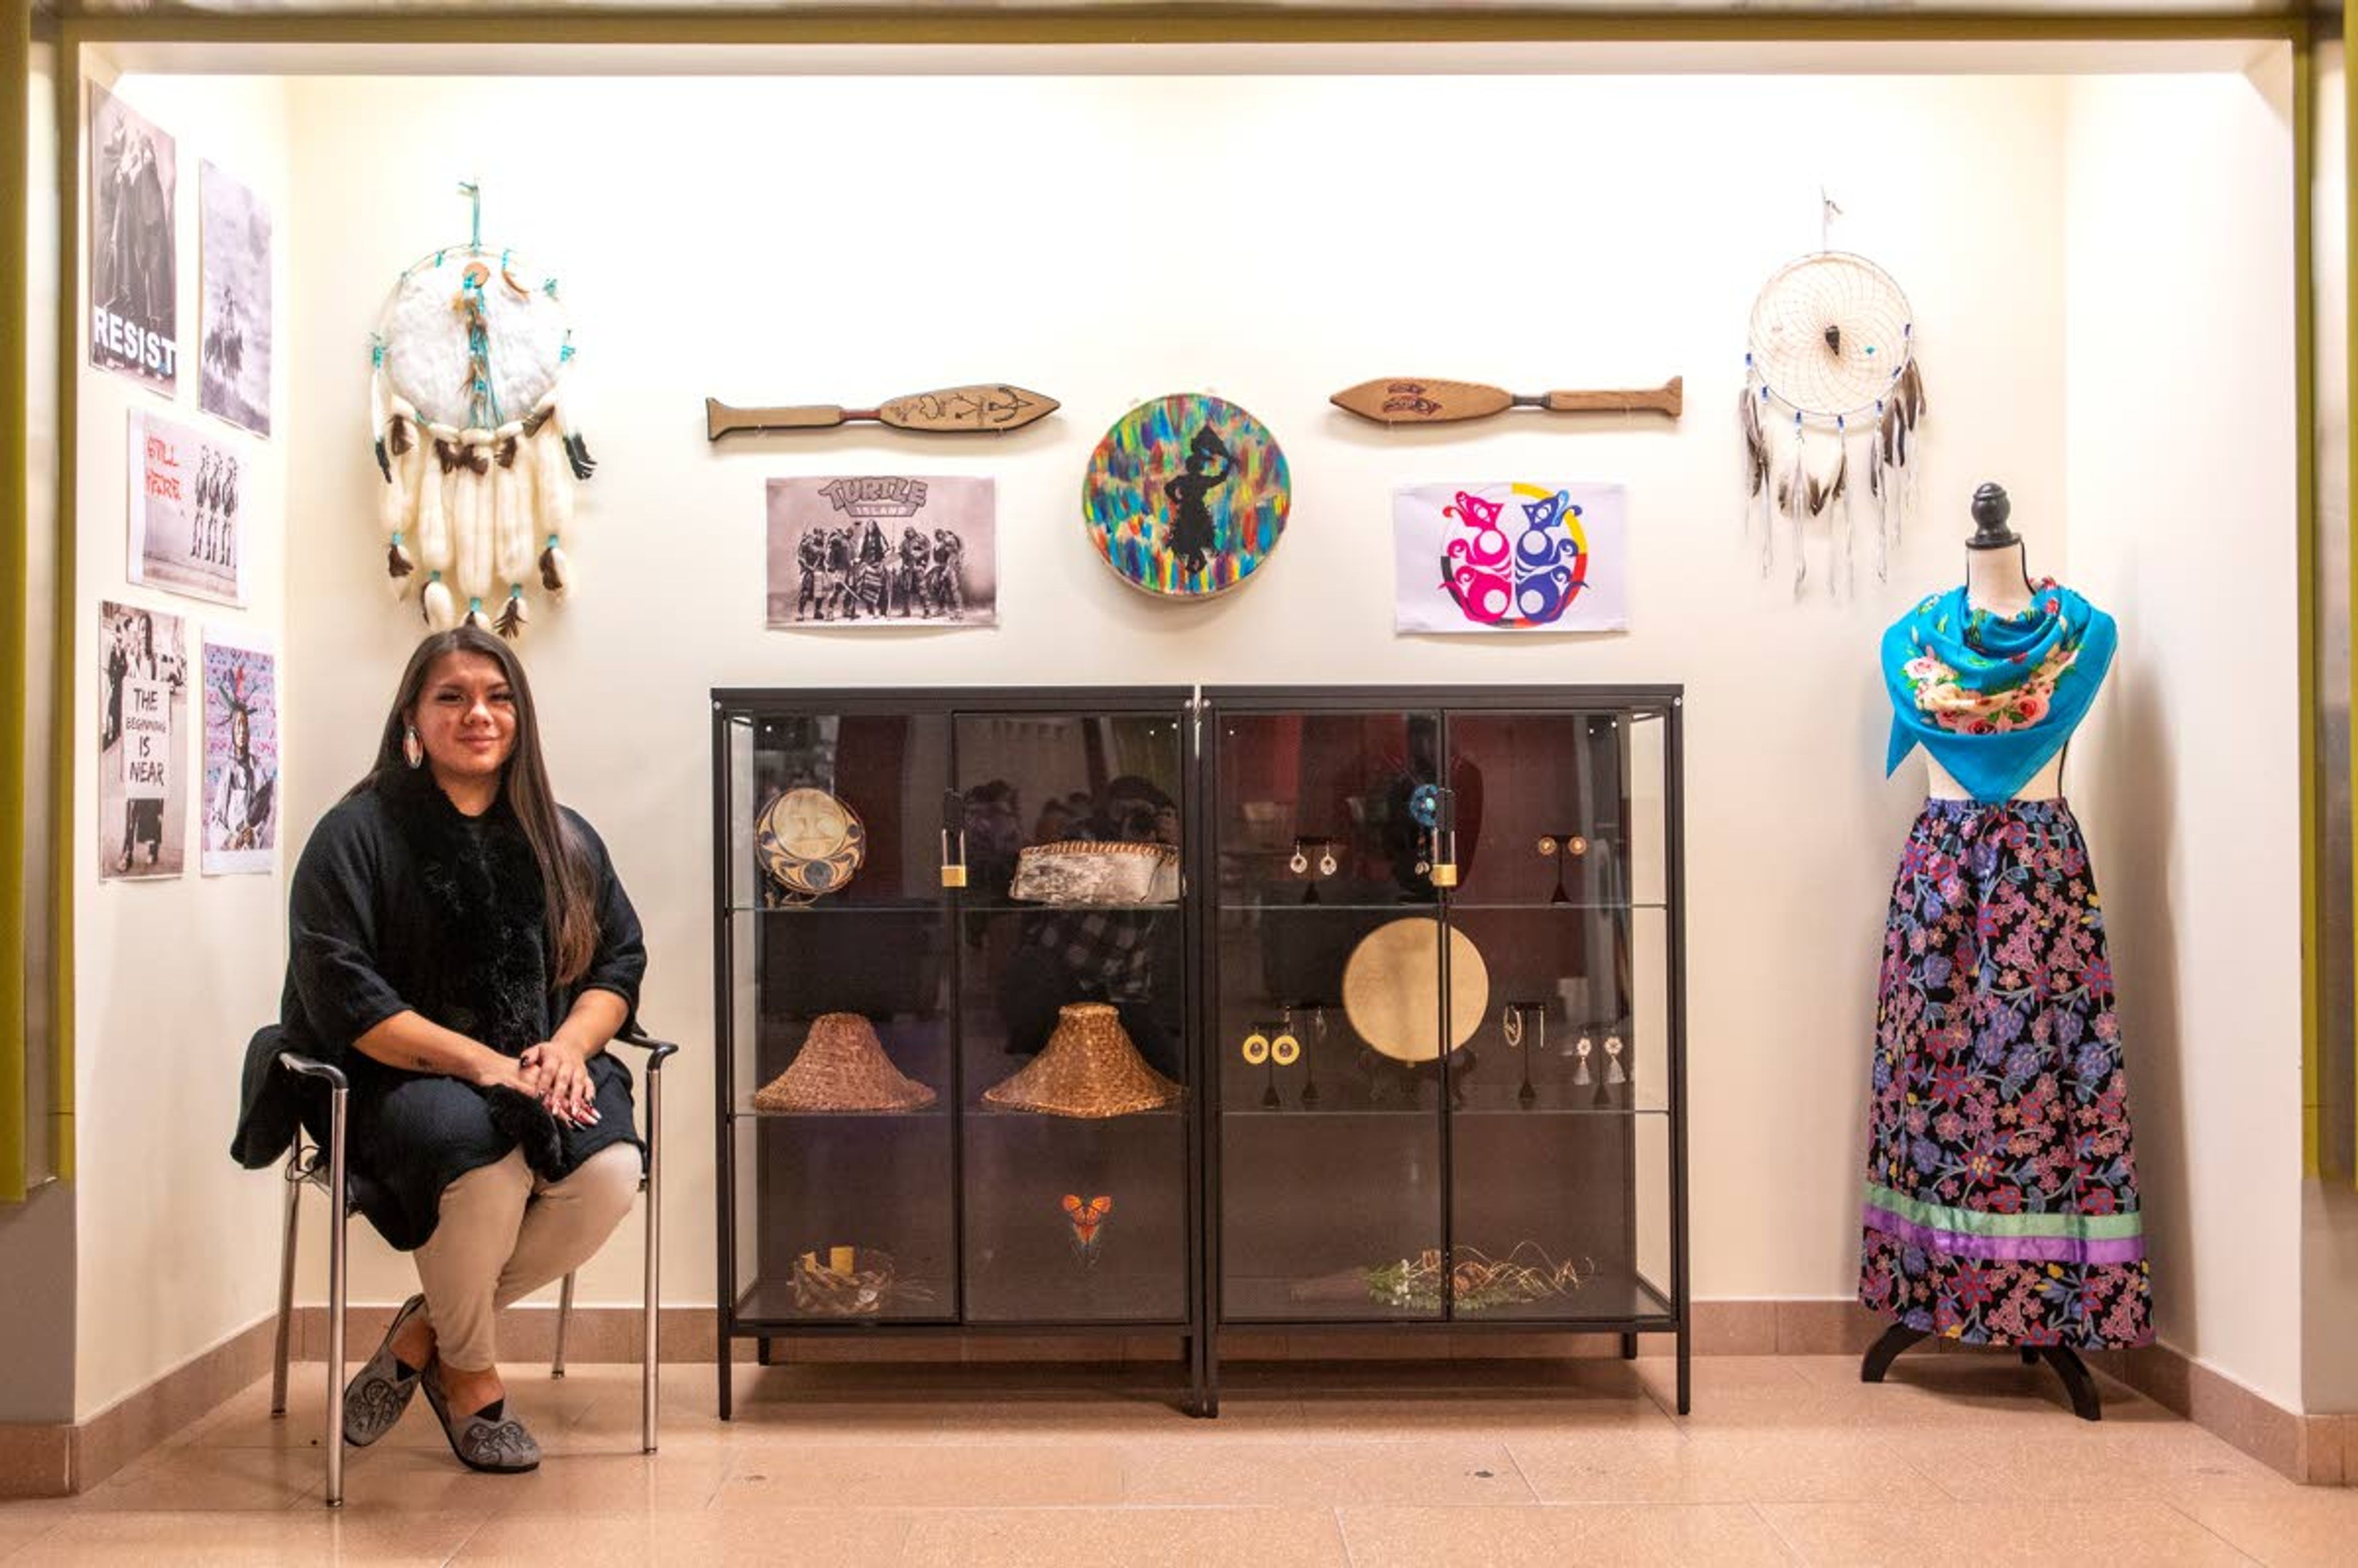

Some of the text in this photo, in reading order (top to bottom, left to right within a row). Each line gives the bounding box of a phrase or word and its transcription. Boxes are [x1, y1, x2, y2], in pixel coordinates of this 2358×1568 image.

[95, 306, 176, 375] RESIST
[147, 435, 179, 467] STILL
[145, 470, 181, 500] HERE
[817, 476, 928, 511] TURTLE
[855, 505, 908, 514] ISLAND
[133, 688, 158, 712] THE
[126, 717, 166, 734] BEGINNING
[139, 735, 150, 758] IS
[130, 761, 165, 786] NEAR
